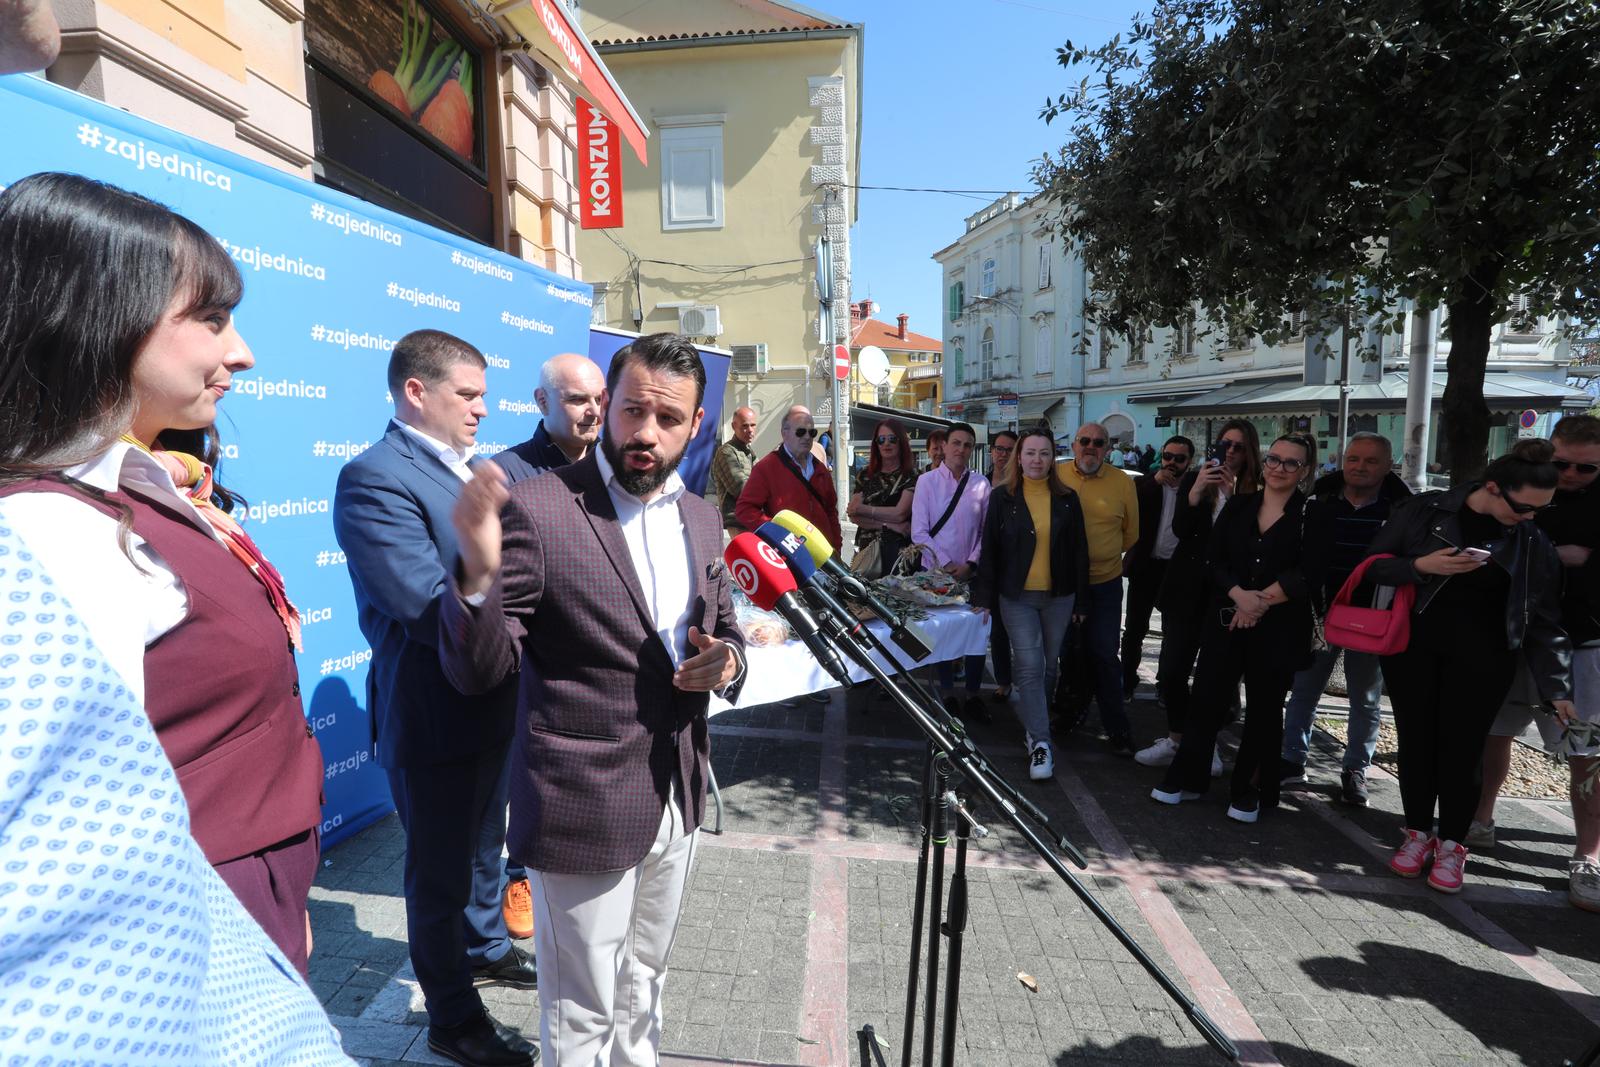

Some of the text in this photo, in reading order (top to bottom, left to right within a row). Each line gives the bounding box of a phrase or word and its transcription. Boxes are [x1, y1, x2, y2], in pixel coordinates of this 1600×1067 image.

[77, 122, 232, 192] #zajednica
[588, 107, 611, 216] KONZUM
[310, 203, 402, 247] #zajednica
[451, 250, 513, 282] #zajednica
[386, 281, 461, 313] #zajednica
[546, 283, 593, 308] #zajednica
[501, 310, 554, 336] #zajednica
[230, 376, 326, 400] zajednica
[312, 439, 372, 461] #zajed
[325, 749, 369, 780] #zaje
